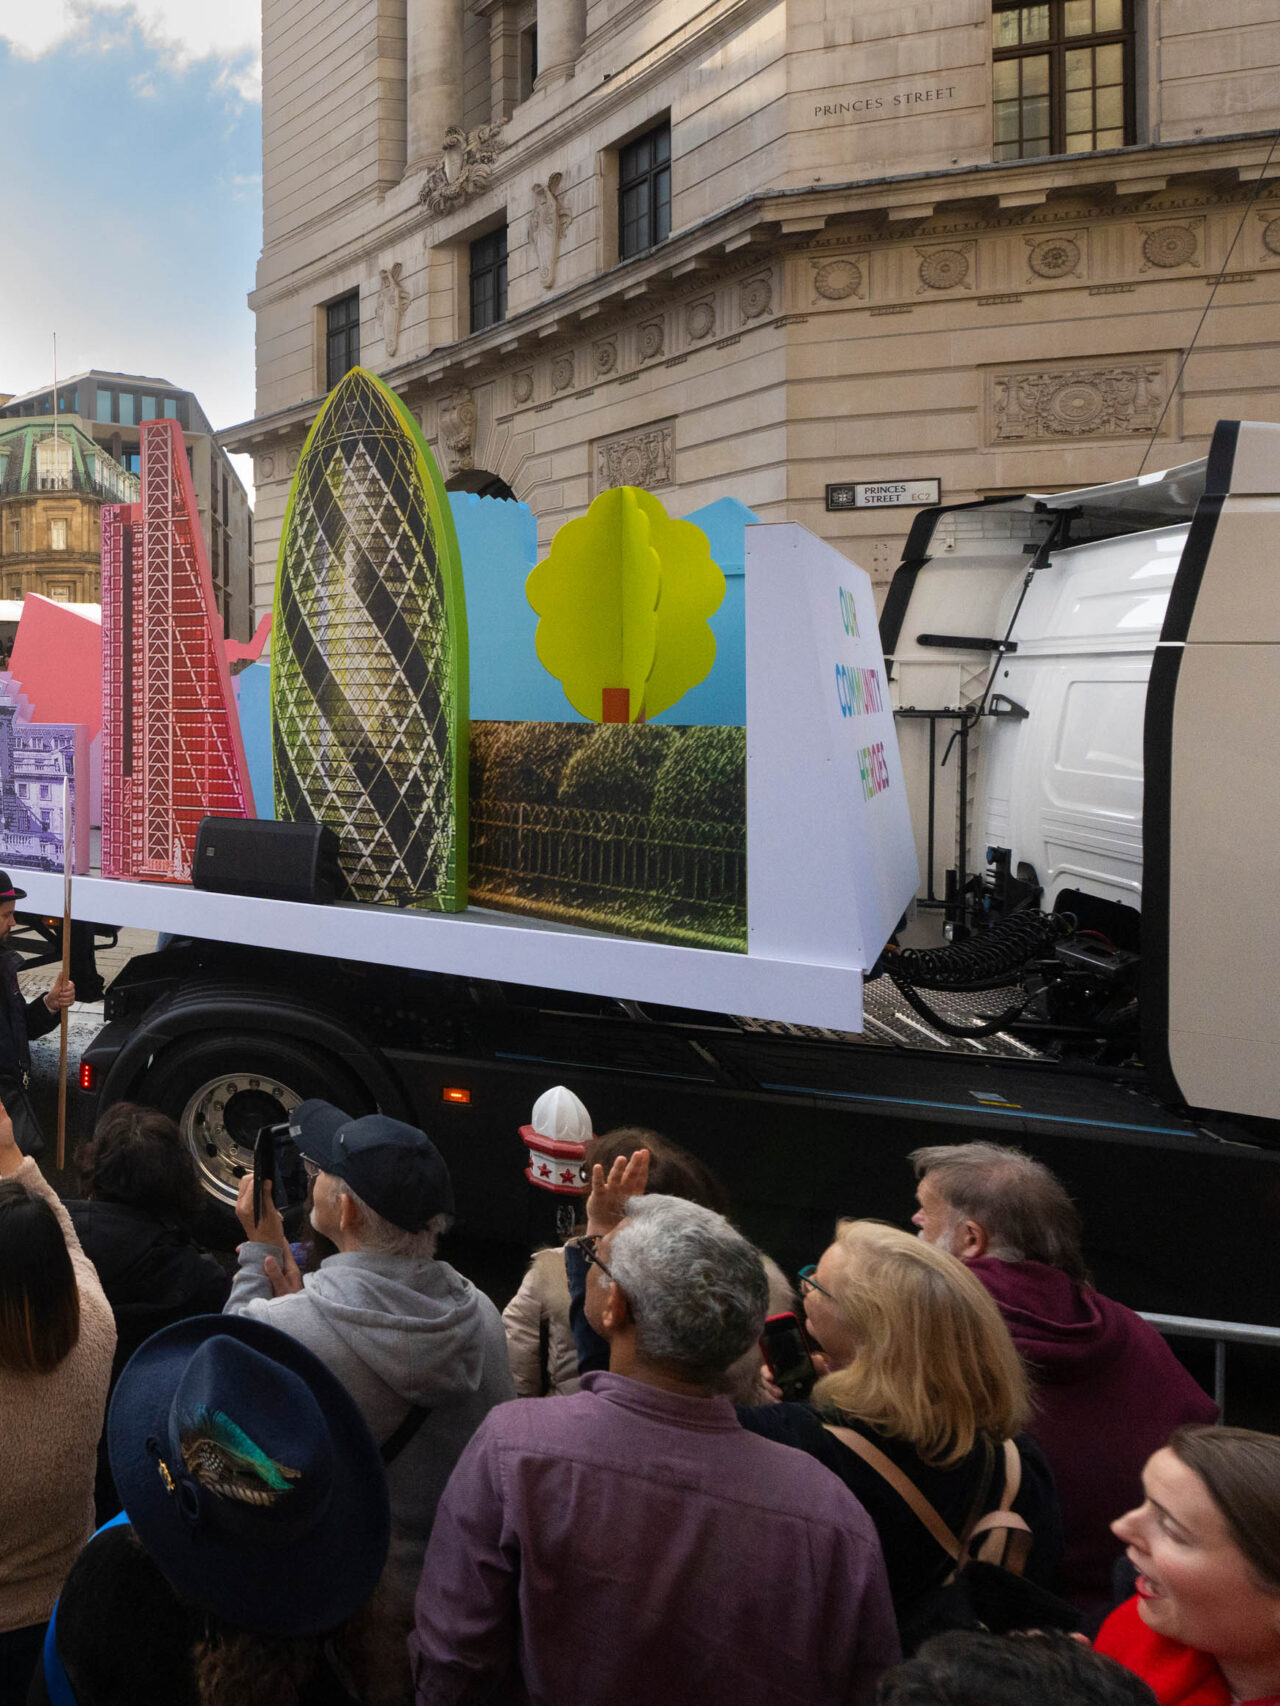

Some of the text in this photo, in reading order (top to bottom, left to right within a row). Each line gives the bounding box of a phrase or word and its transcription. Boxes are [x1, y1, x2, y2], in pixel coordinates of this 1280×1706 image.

[814, 86, 956, 117] PRINCES STREET
[864, 485, 906, 495] PRINCES
[864, 492, 930, 504] STREET EC2
[840, 585, 861, 639] OUR
[835, 663, 884, 718] COMMUNITY
[857, 741, 890, 803] HEROES
